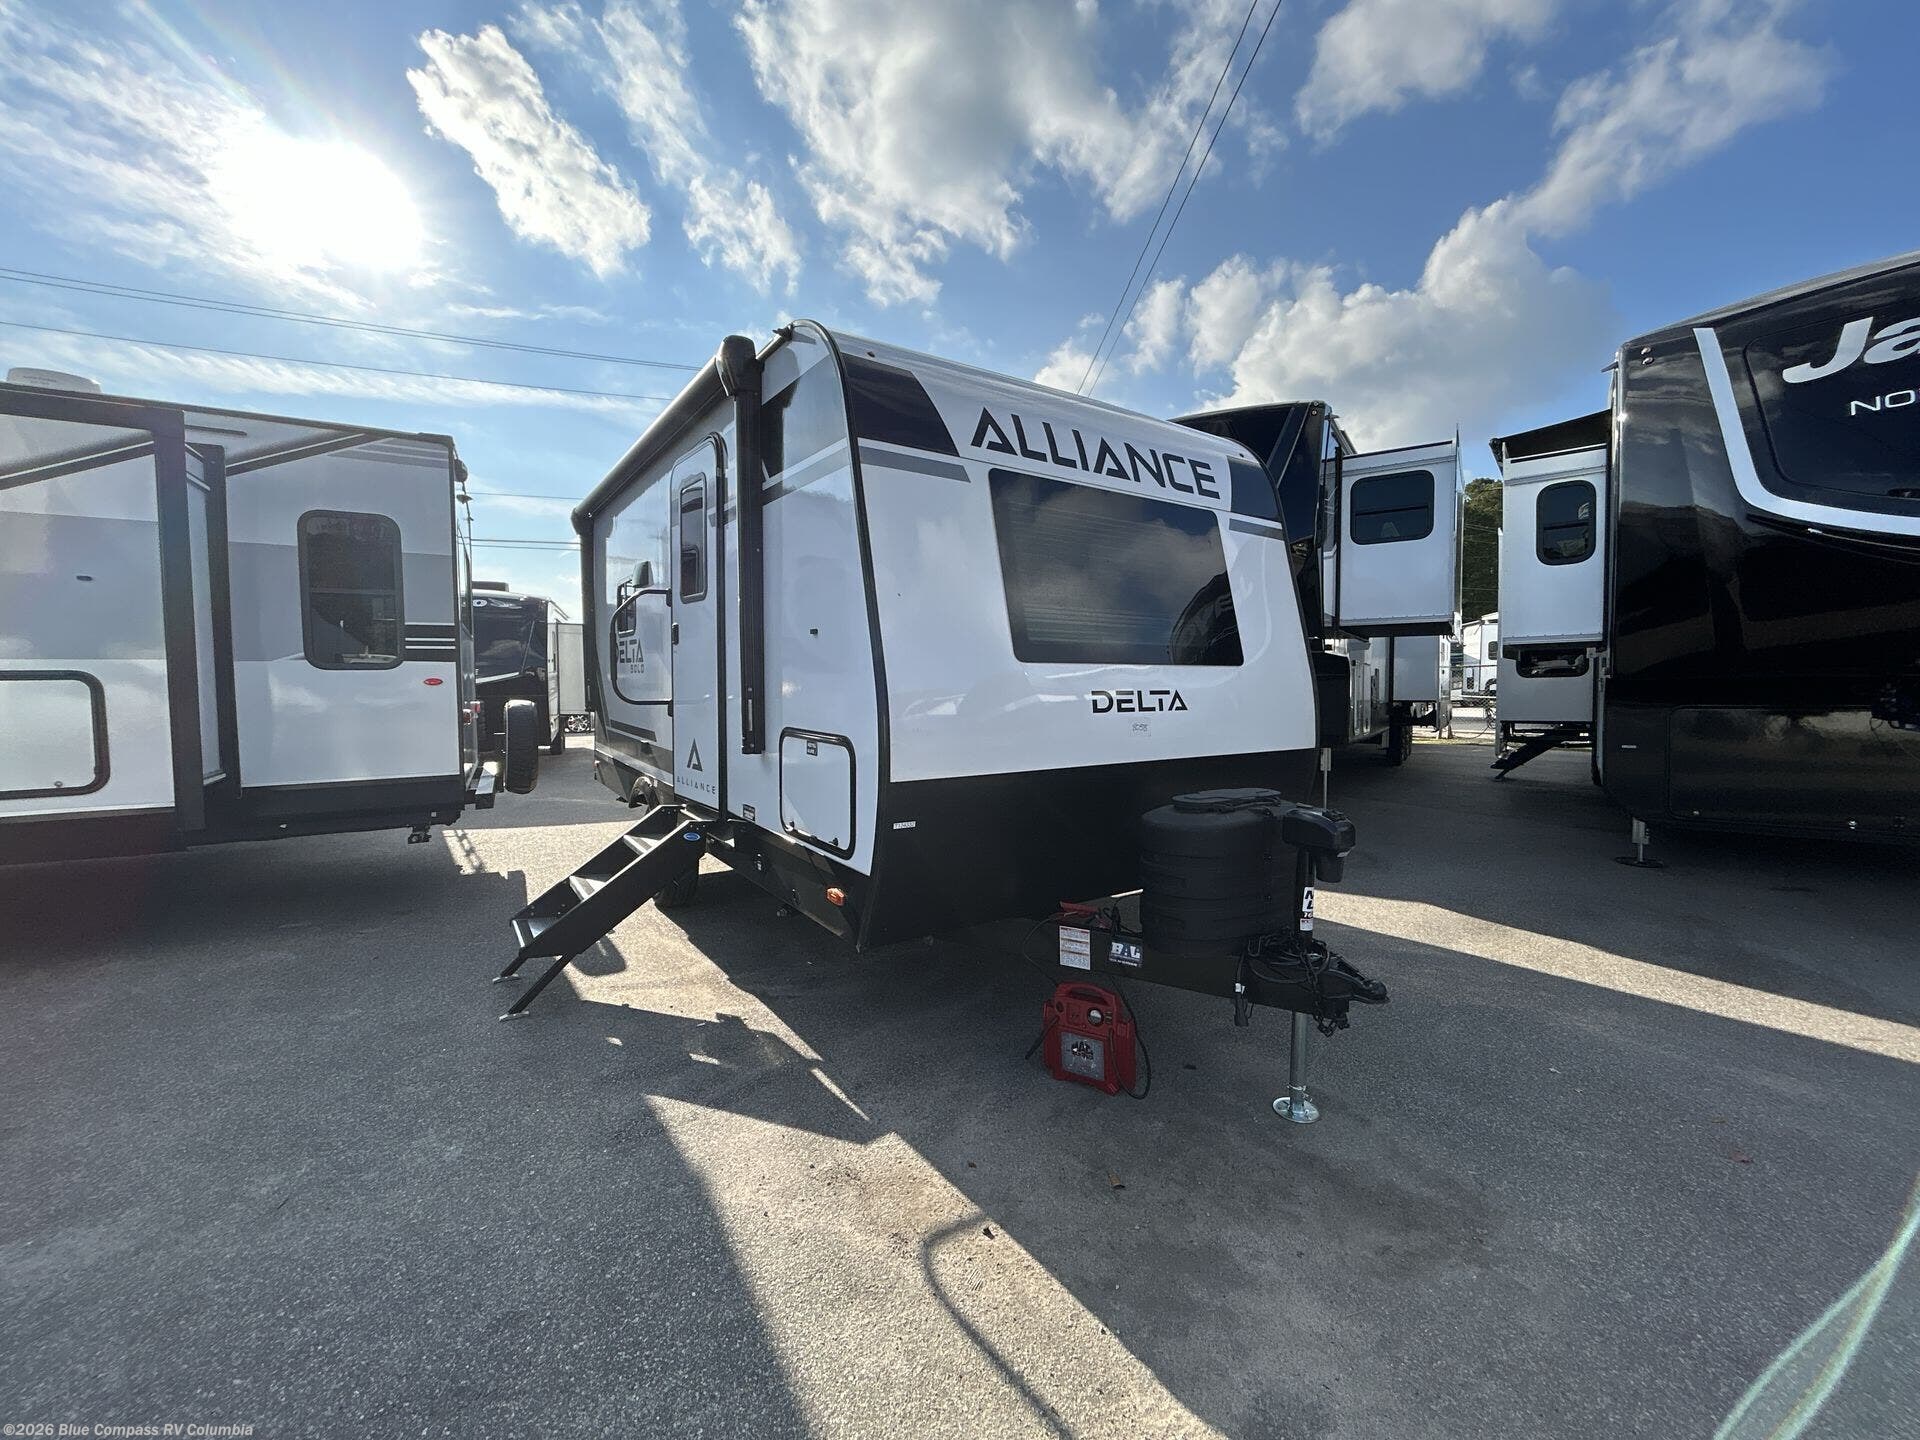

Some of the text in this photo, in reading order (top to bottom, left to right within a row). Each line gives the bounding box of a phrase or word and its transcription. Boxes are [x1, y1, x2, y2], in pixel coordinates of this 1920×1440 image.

[1782, 316, 1920, 384] Ja
[1850, 389, 1916, 416] NO
[970, 406, 1221, 500] ALLIANCE
[616, 639, 644, 663] ELTA
[1091, 689, 1188, 713] DELTA
[676, 775, 716, 794] ALLIANCE
